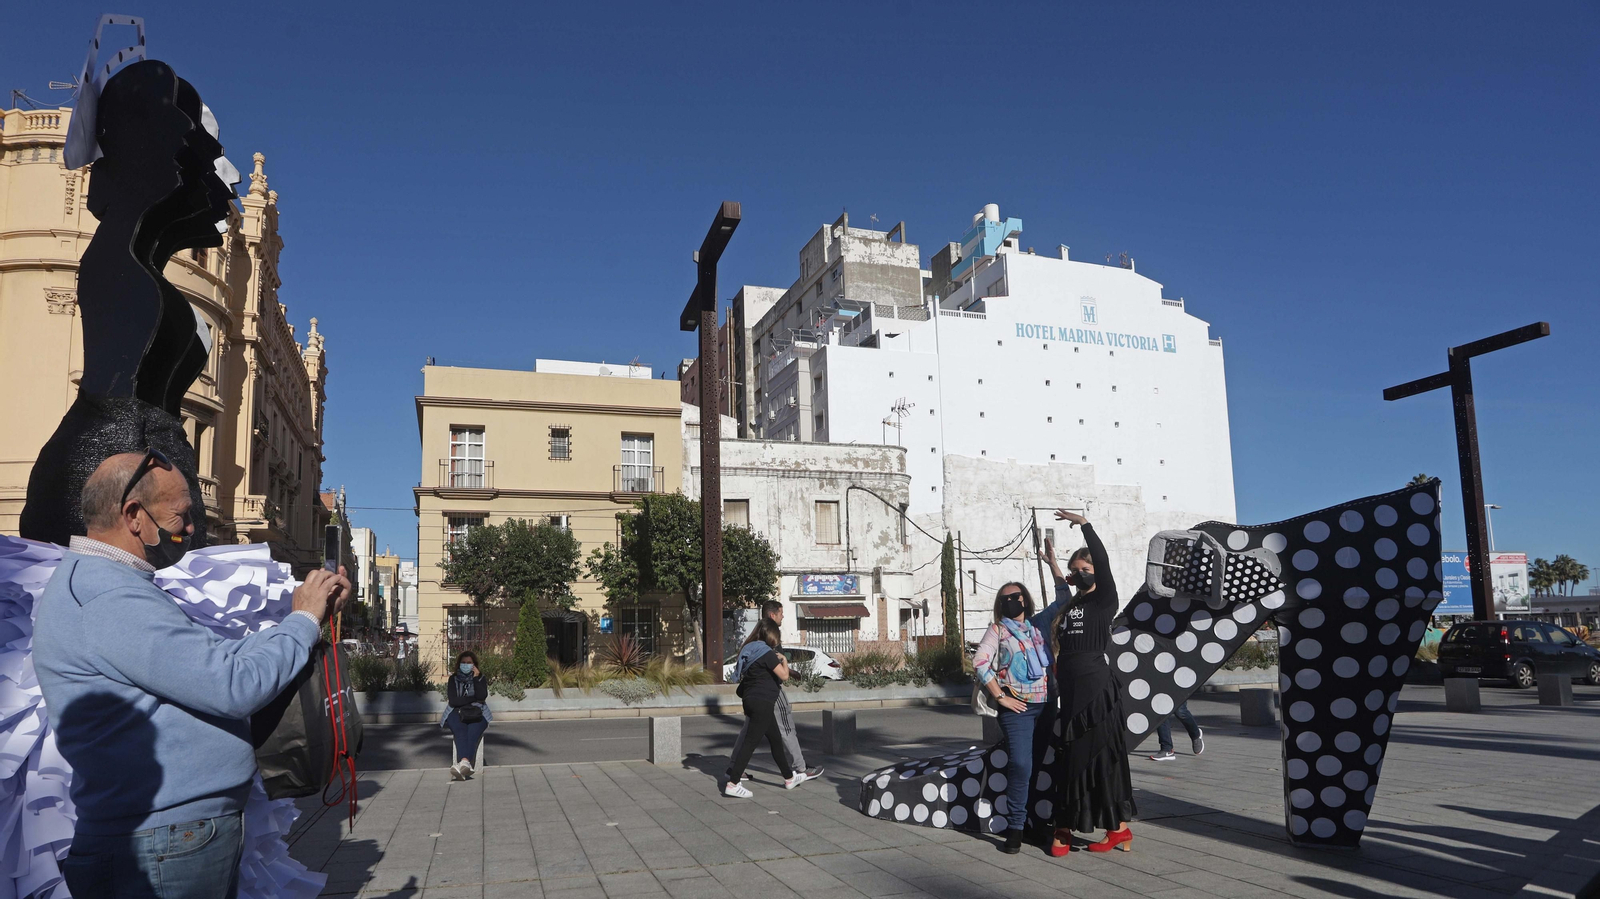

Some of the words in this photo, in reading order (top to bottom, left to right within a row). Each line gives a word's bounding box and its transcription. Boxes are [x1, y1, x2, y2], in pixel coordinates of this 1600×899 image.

[1015, 323, 1056, 341] HOTEL
[1058, 327, 1104, 346] MARINA
[1106, 332, 1159, 351] VICTORIA
